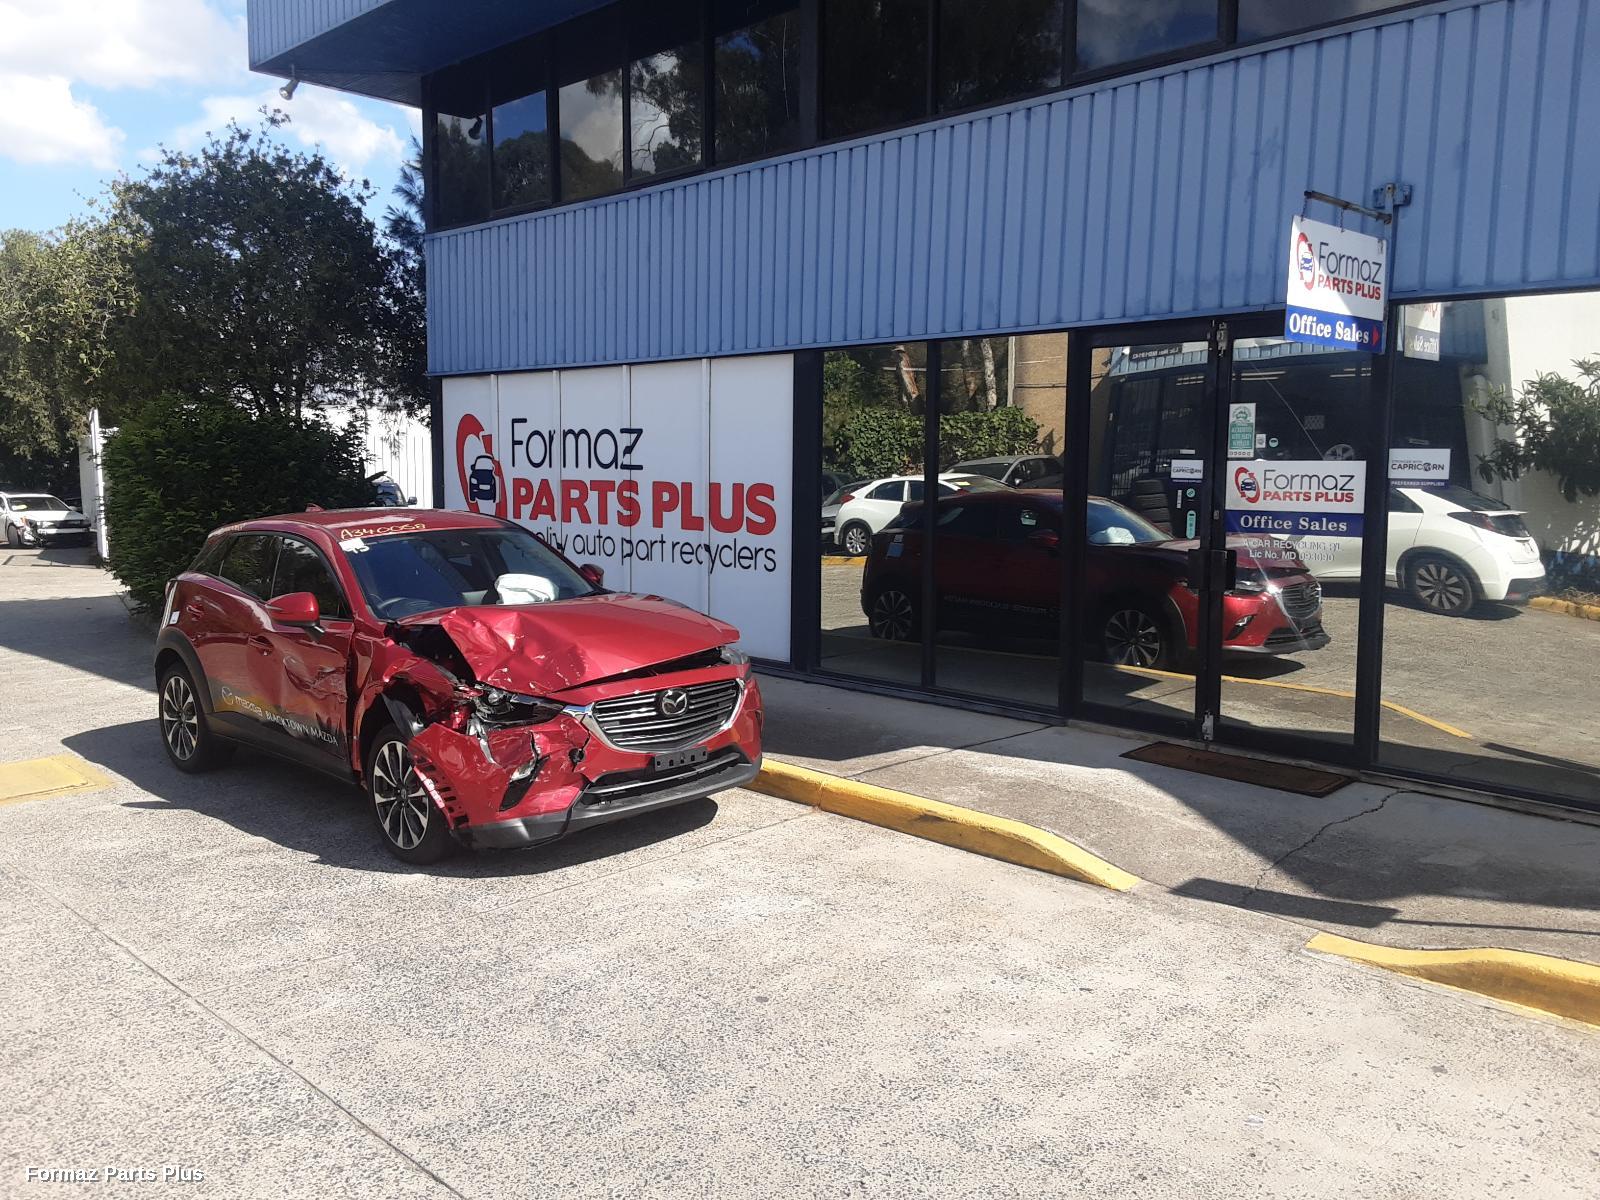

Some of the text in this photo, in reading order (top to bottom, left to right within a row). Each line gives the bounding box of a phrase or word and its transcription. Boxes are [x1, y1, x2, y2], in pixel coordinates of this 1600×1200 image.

[1319, 241, 1382, 285] Formaz
[1318, 274, 1381, 300] PARTS PLUS
[1289, 312, 1370, 343] Office Sales
[511, 417, 644, 471] Formaz
[1263, 469, 1355, 491] Formaz
[1391, 462, 1445, 472] CAPRICORN
[512, 477, 777, 536] PARTS PLUS
[1263, 490, 1354, 503] PARTS PLUS
[1240, 514, 1348, 532] Office Sales
[572, 529, 616, 557] auto
[621, 533, 666, 566] part
[671, 537, 777, 574] recyclers
[1249, 549, 1262, 558] Lic
[1264, 550, 1279, 559] No.
[1281, 551, 1297, 560] MD
[265, 710, 309, 735] BLACKTOWN
[310, 726, 339, 747] MAZDA
